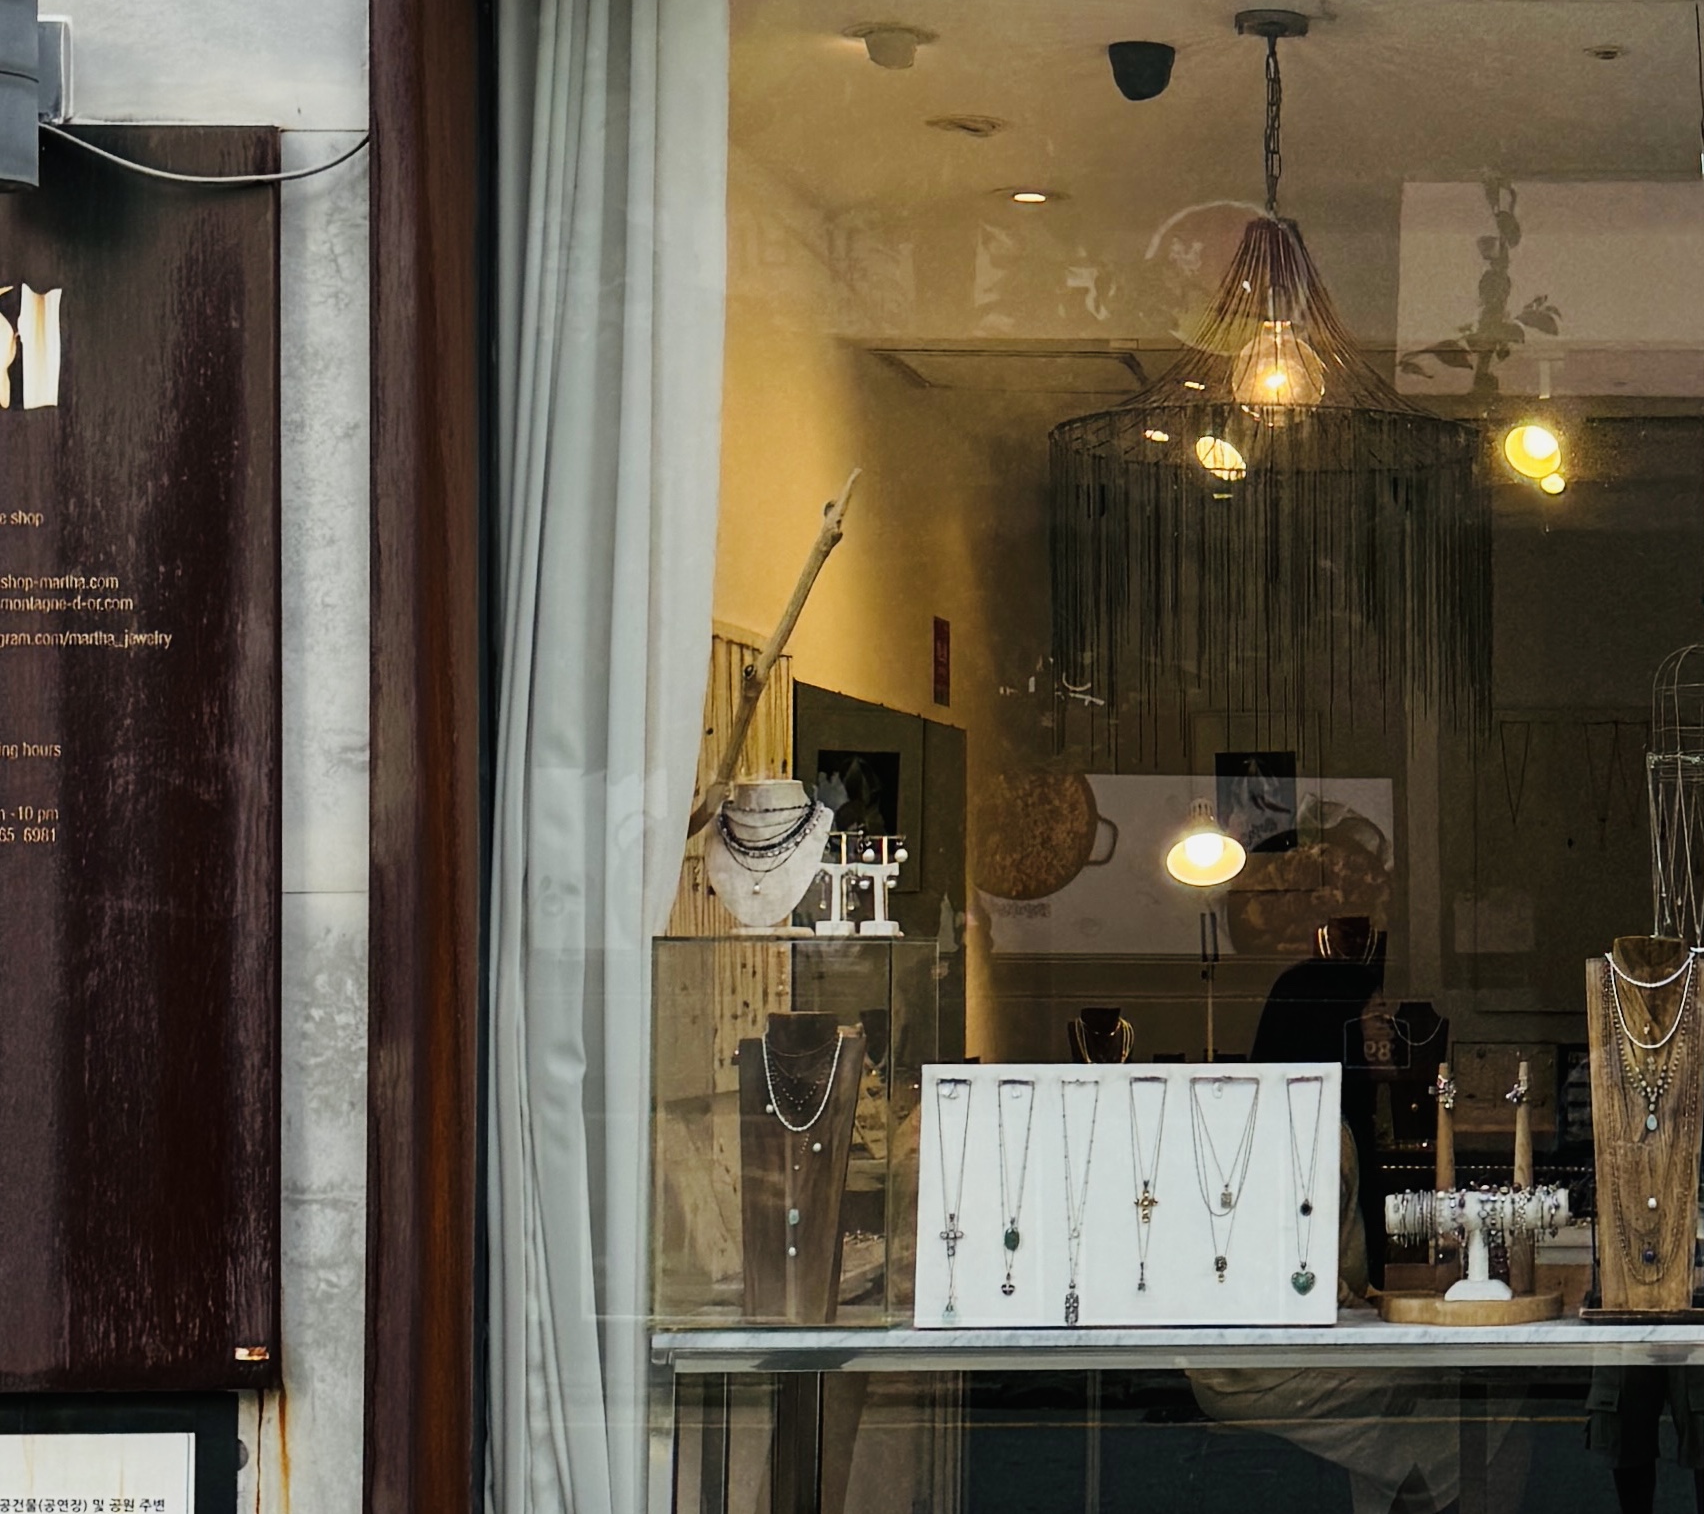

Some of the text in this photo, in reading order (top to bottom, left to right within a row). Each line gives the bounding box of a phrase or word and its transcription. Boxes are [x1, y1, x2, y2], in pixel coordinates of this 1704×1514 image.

[10, 510, 44, 527] shop
[0, 574, 119, 592] shop-martha.com
[0, 595, 134, 613] montagne-d-or.com
[22, 741, 62, 757] hours
[37, 808, 59, 824] pm
[23, 826, 56, 843] 6981
[92, 1498, 104, 1513] 및
[109, 1498, 135, 1513] 공원
[139, 1498, 165, 1513] 주변
